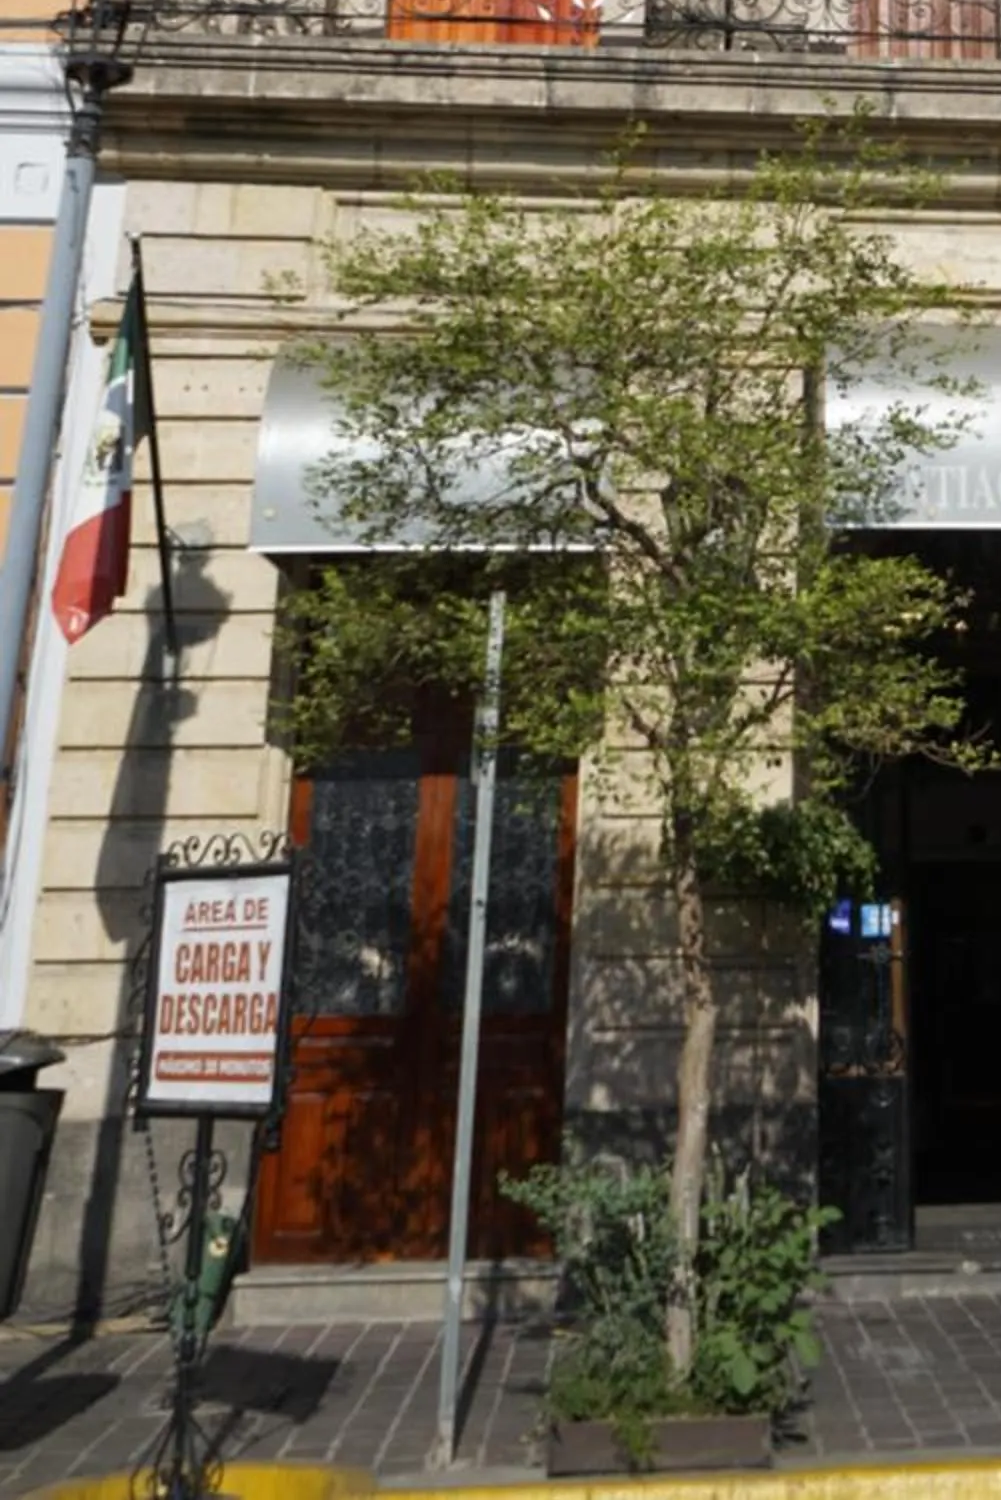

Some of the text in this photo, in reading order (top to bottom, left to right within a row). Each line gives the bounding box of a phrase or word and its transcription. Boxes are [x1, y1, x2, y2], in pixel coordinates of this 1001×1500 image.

[243, 897, 269, 921] DE
[175, 940, 272, 984] CARGA Y
[159, 992, 277, 1035] DESCARGA
